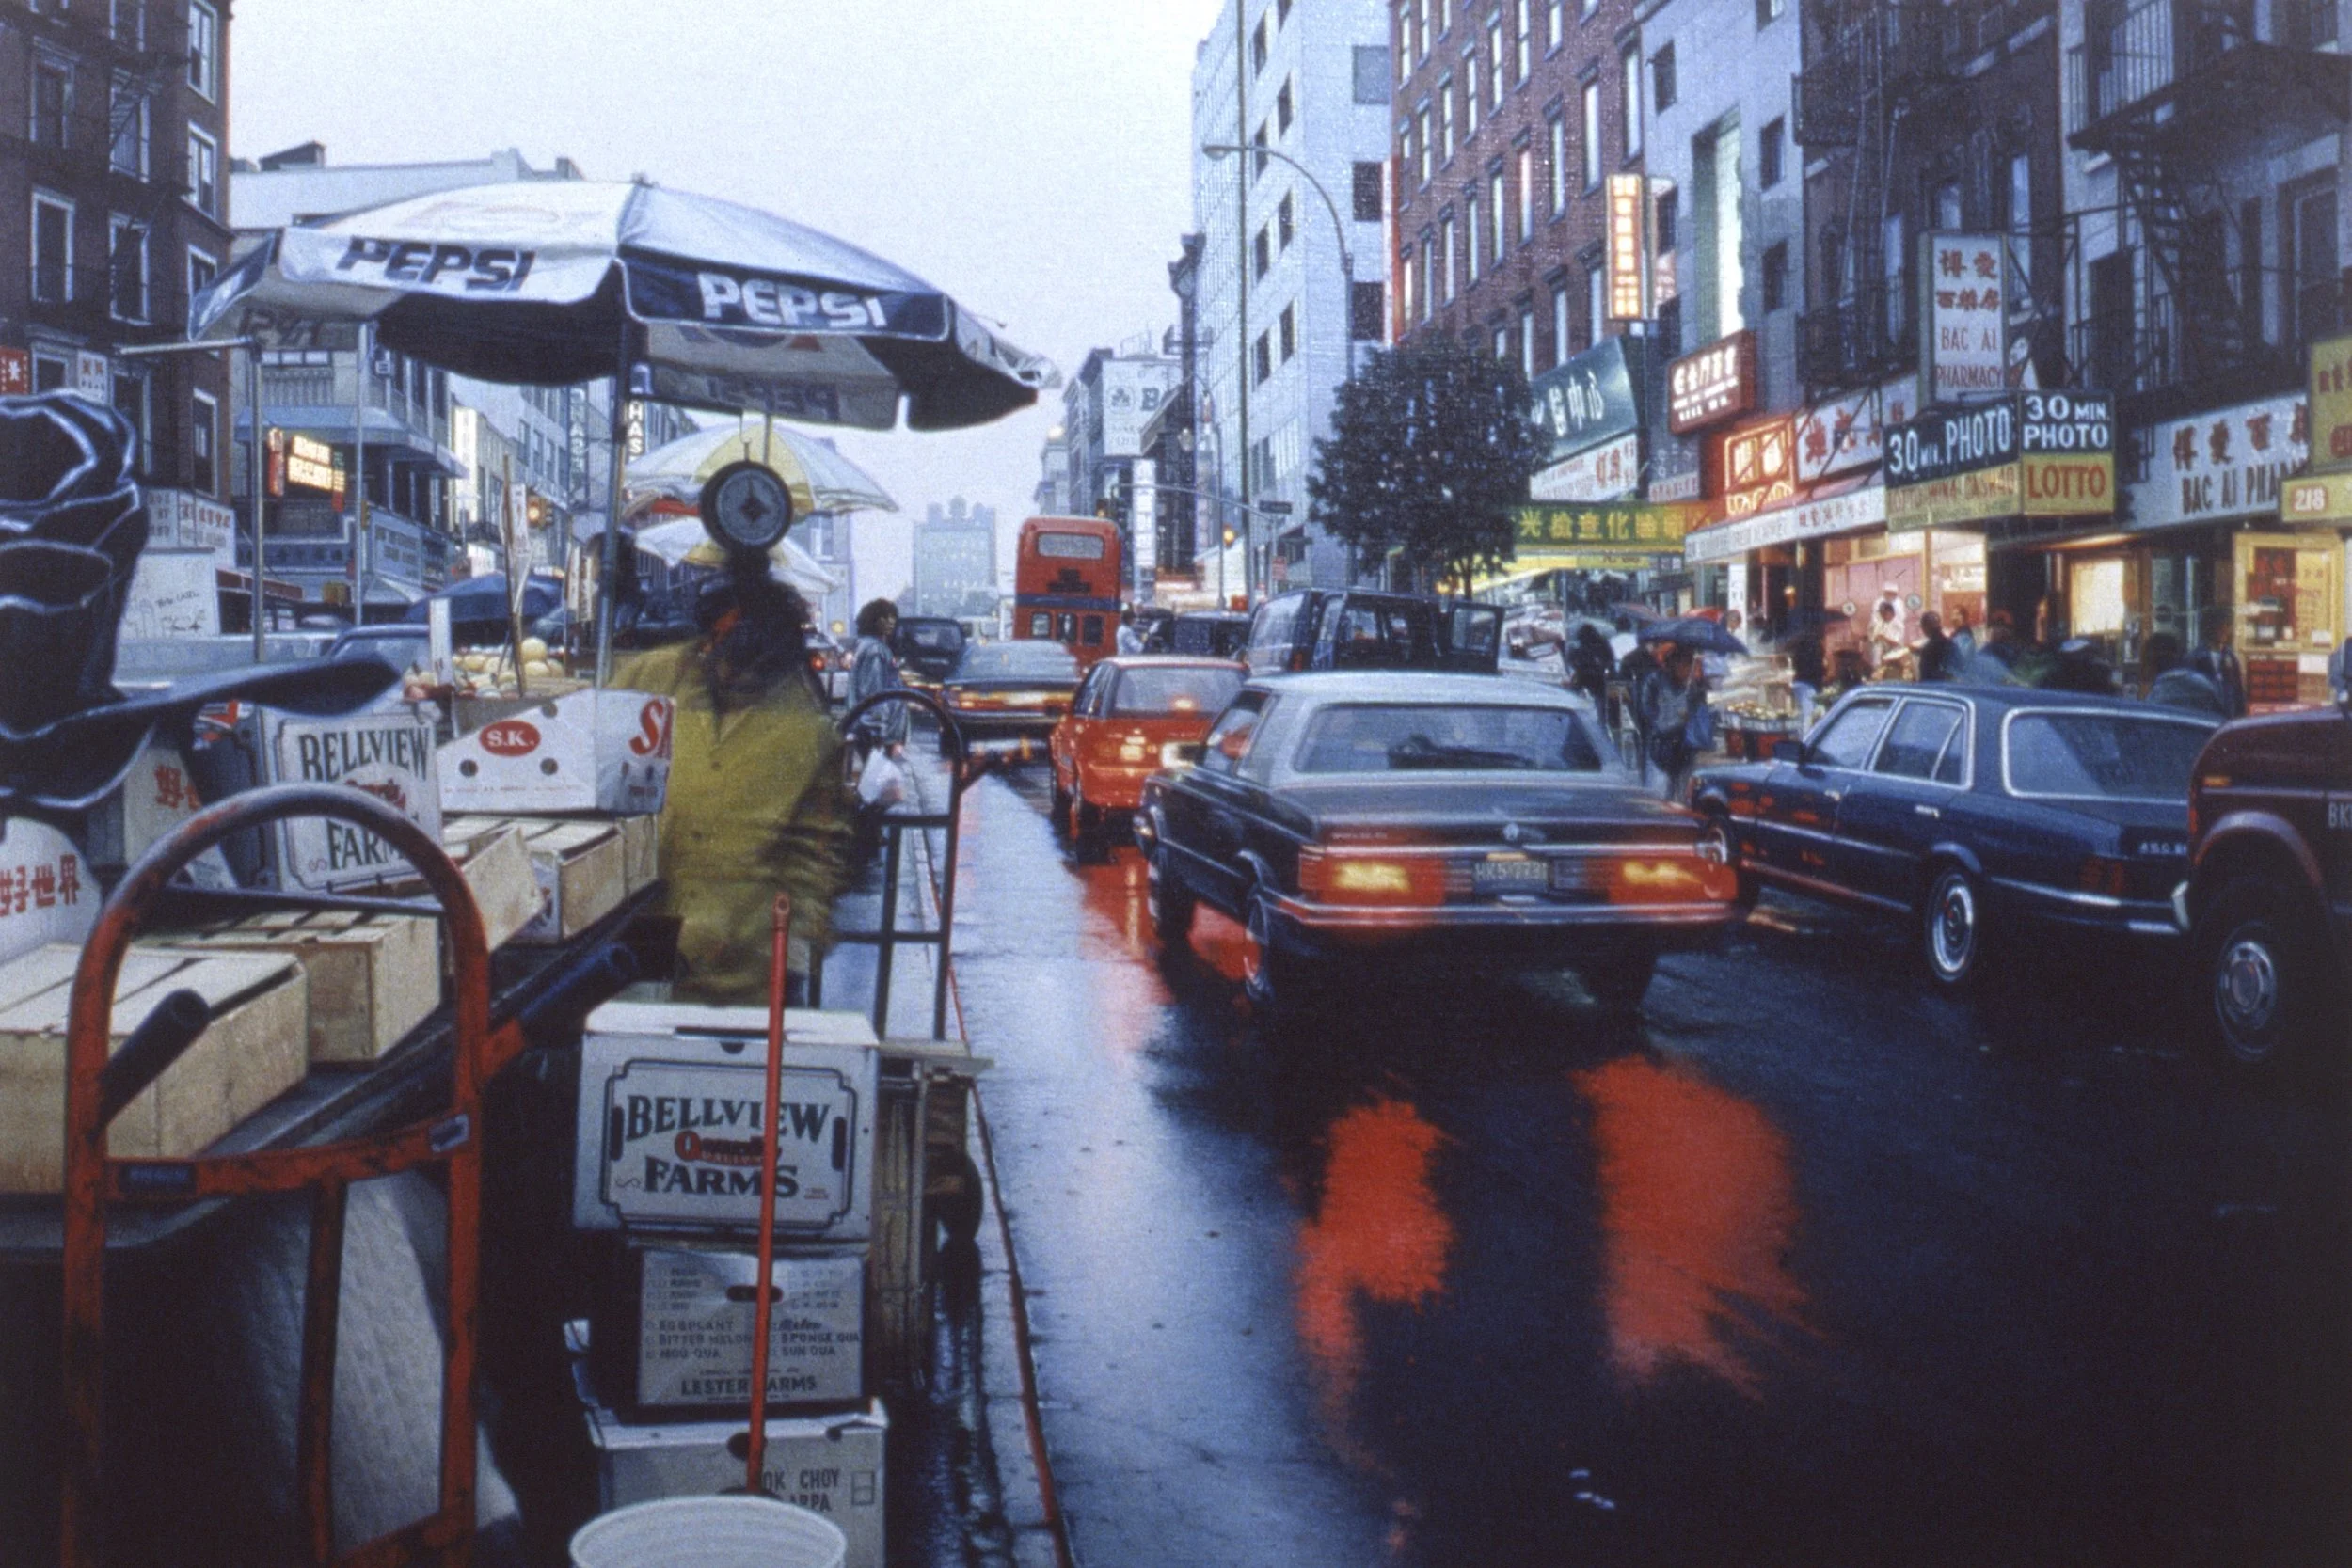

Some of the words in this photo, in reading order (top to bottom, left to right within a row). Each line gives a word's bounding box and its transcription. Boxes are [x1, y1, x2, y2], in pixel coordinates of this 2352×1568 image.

[337, 237, 535, 291] PEPSI
[697, 272, 887, 328] PEPSI
[1941, 326, 1969, 351] BAC
[1981, 327, 1996, 351] AI
[1935, 364, 2003, 388] PHARMACY
[2025, 395, 2070, 421] 30
[2074, 402, 2111, 421] MIN.
[1888, 429, 1919, 475] 30
[1944, 405, 2010, 465] PHOTO
[2024, 423, 2109, 450] PHOTO
[2027, 465, 2106, 499] LOTTO
[2182, 474, 2213, 515] BAC
[626, 1094, 832, 1144] BELLVIEW
[644, 1155, 799, 1199] FARMS
[660, 1319, 734, 1332] EGGPLANT
[780, 1333, 832, 1344] SPONGE
[837, 1332, 860, 1343] QUA
[660, 1334, 706, 1347] BITTER
[693, 1347, 722, 1359] QUA
[781, 1346, 806, 1357] SUN
[809, 1345, 836, 1356] QUA
[680, 1379, 749, 1397] LESTER
[765, 1375, 818, 1393] ARMS
[799, 1468, 839, 1489] CHOY
